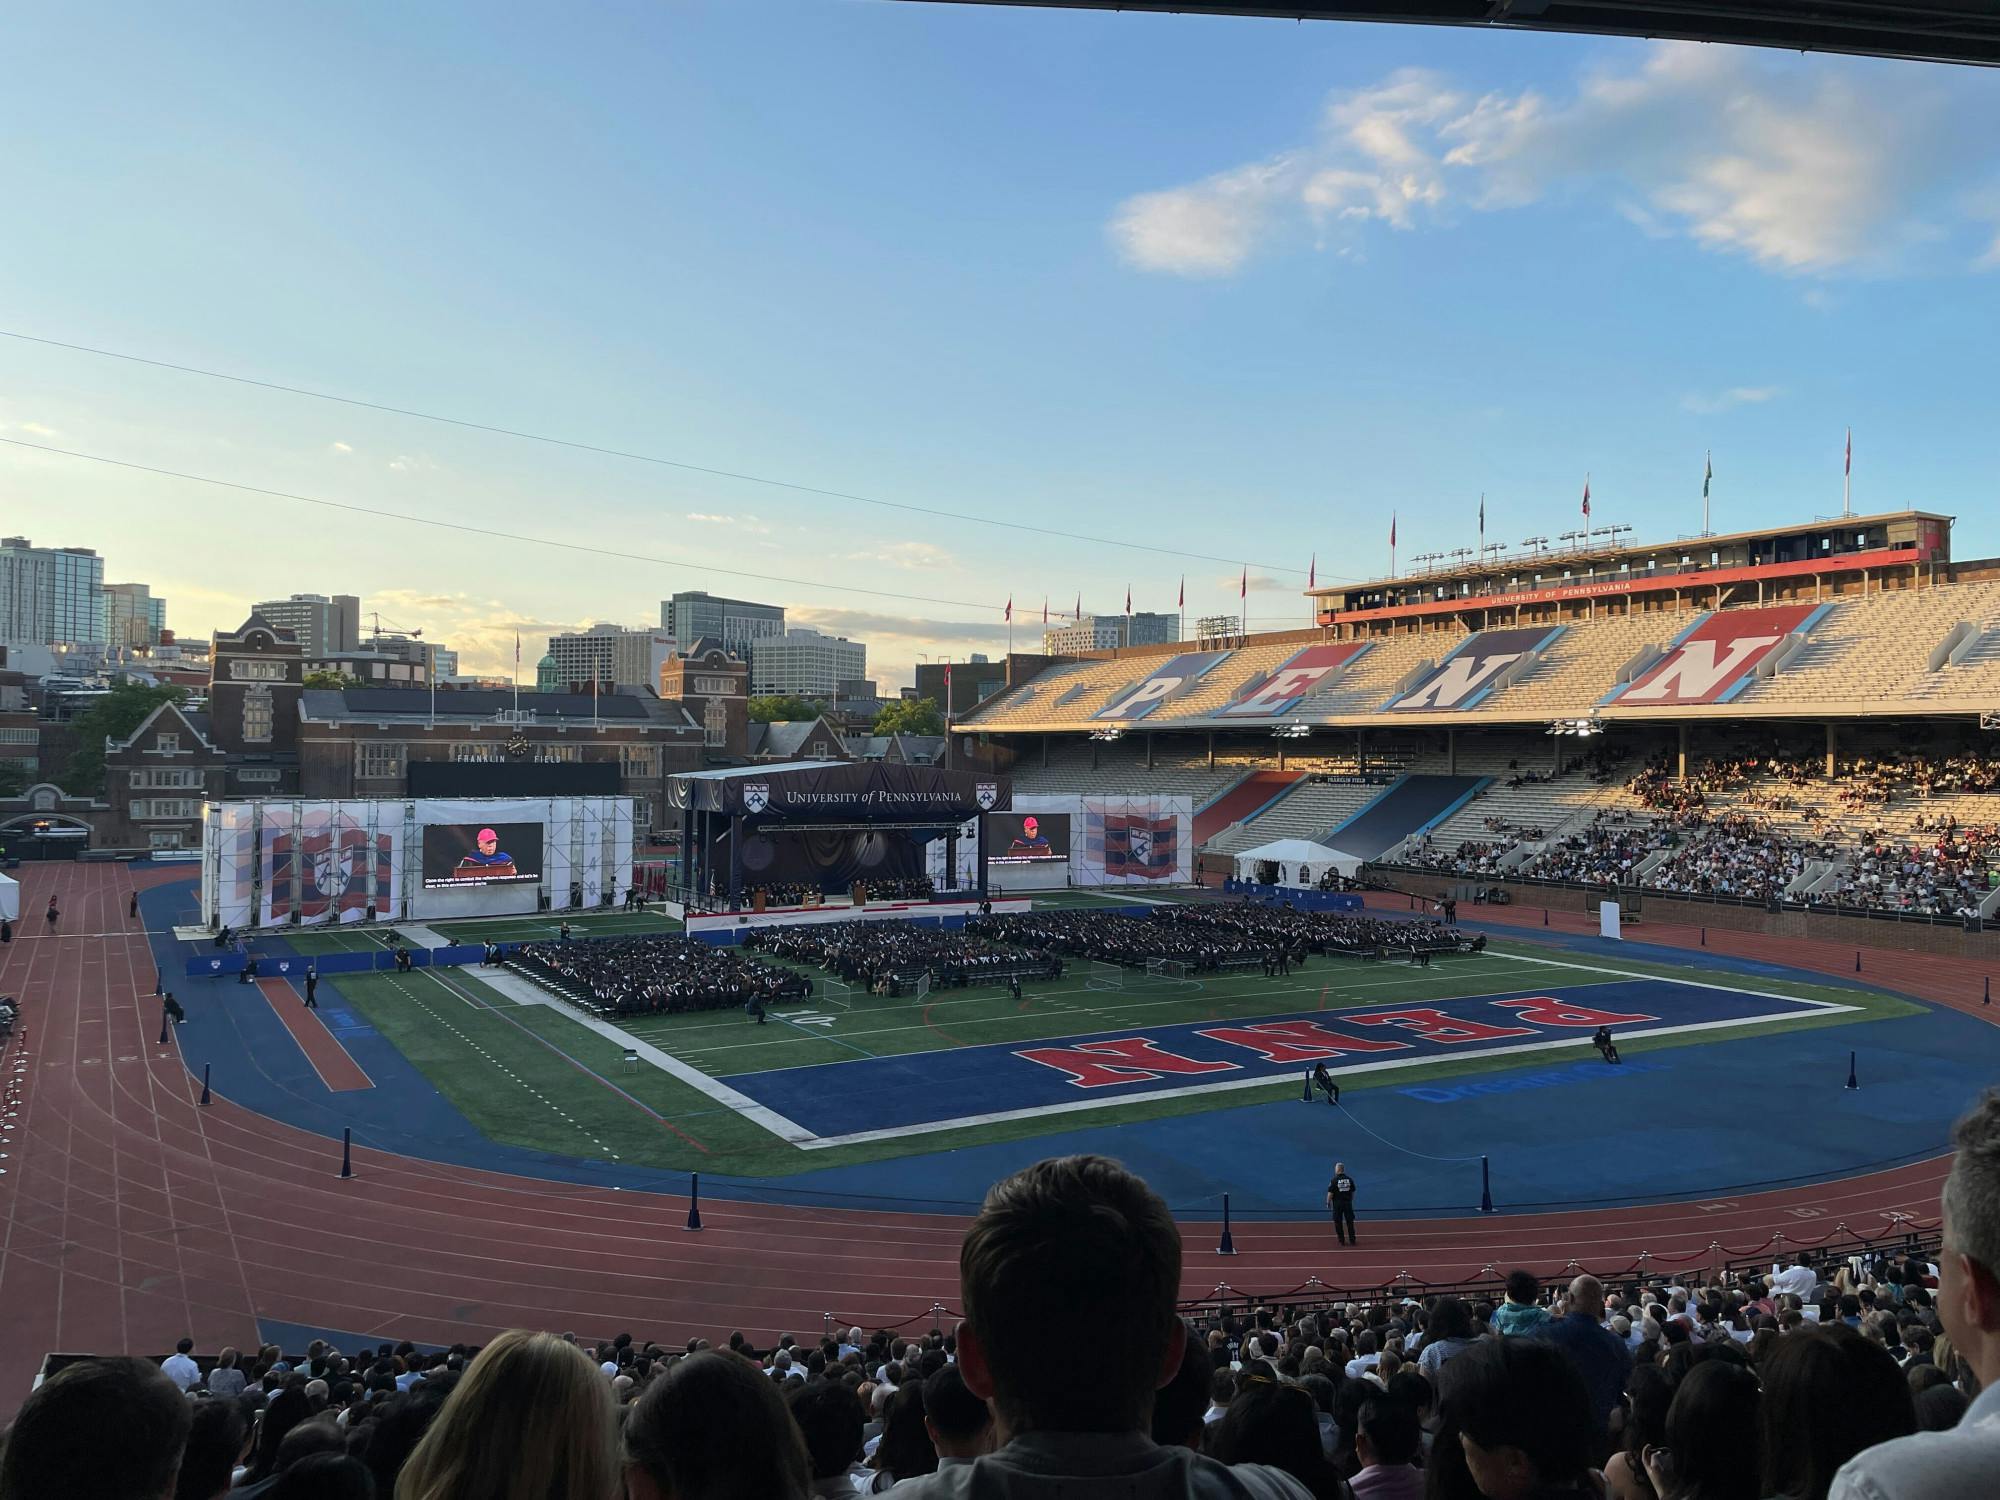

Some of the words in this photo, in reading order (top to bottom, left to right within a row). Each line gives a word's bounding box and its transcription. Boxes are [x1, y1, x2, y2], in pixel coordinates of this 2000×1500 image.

[1491, 593, 1539, 604] UNIVERSITY
[1546, 590, 1556, 598] OF
[1563, 583, 1631, 597] PENNSYLVANIA
[457, 755, 505, 763] FRANKLIN
[535, 755, 561, 763] FIELD
[787, 791, 859, 804] UNIVERSITY
[861, 790, 876, 805] of
[878, 790, 961, 802] PENNSYLVANIA
[1011, 996, 1662, 1087] PENN
